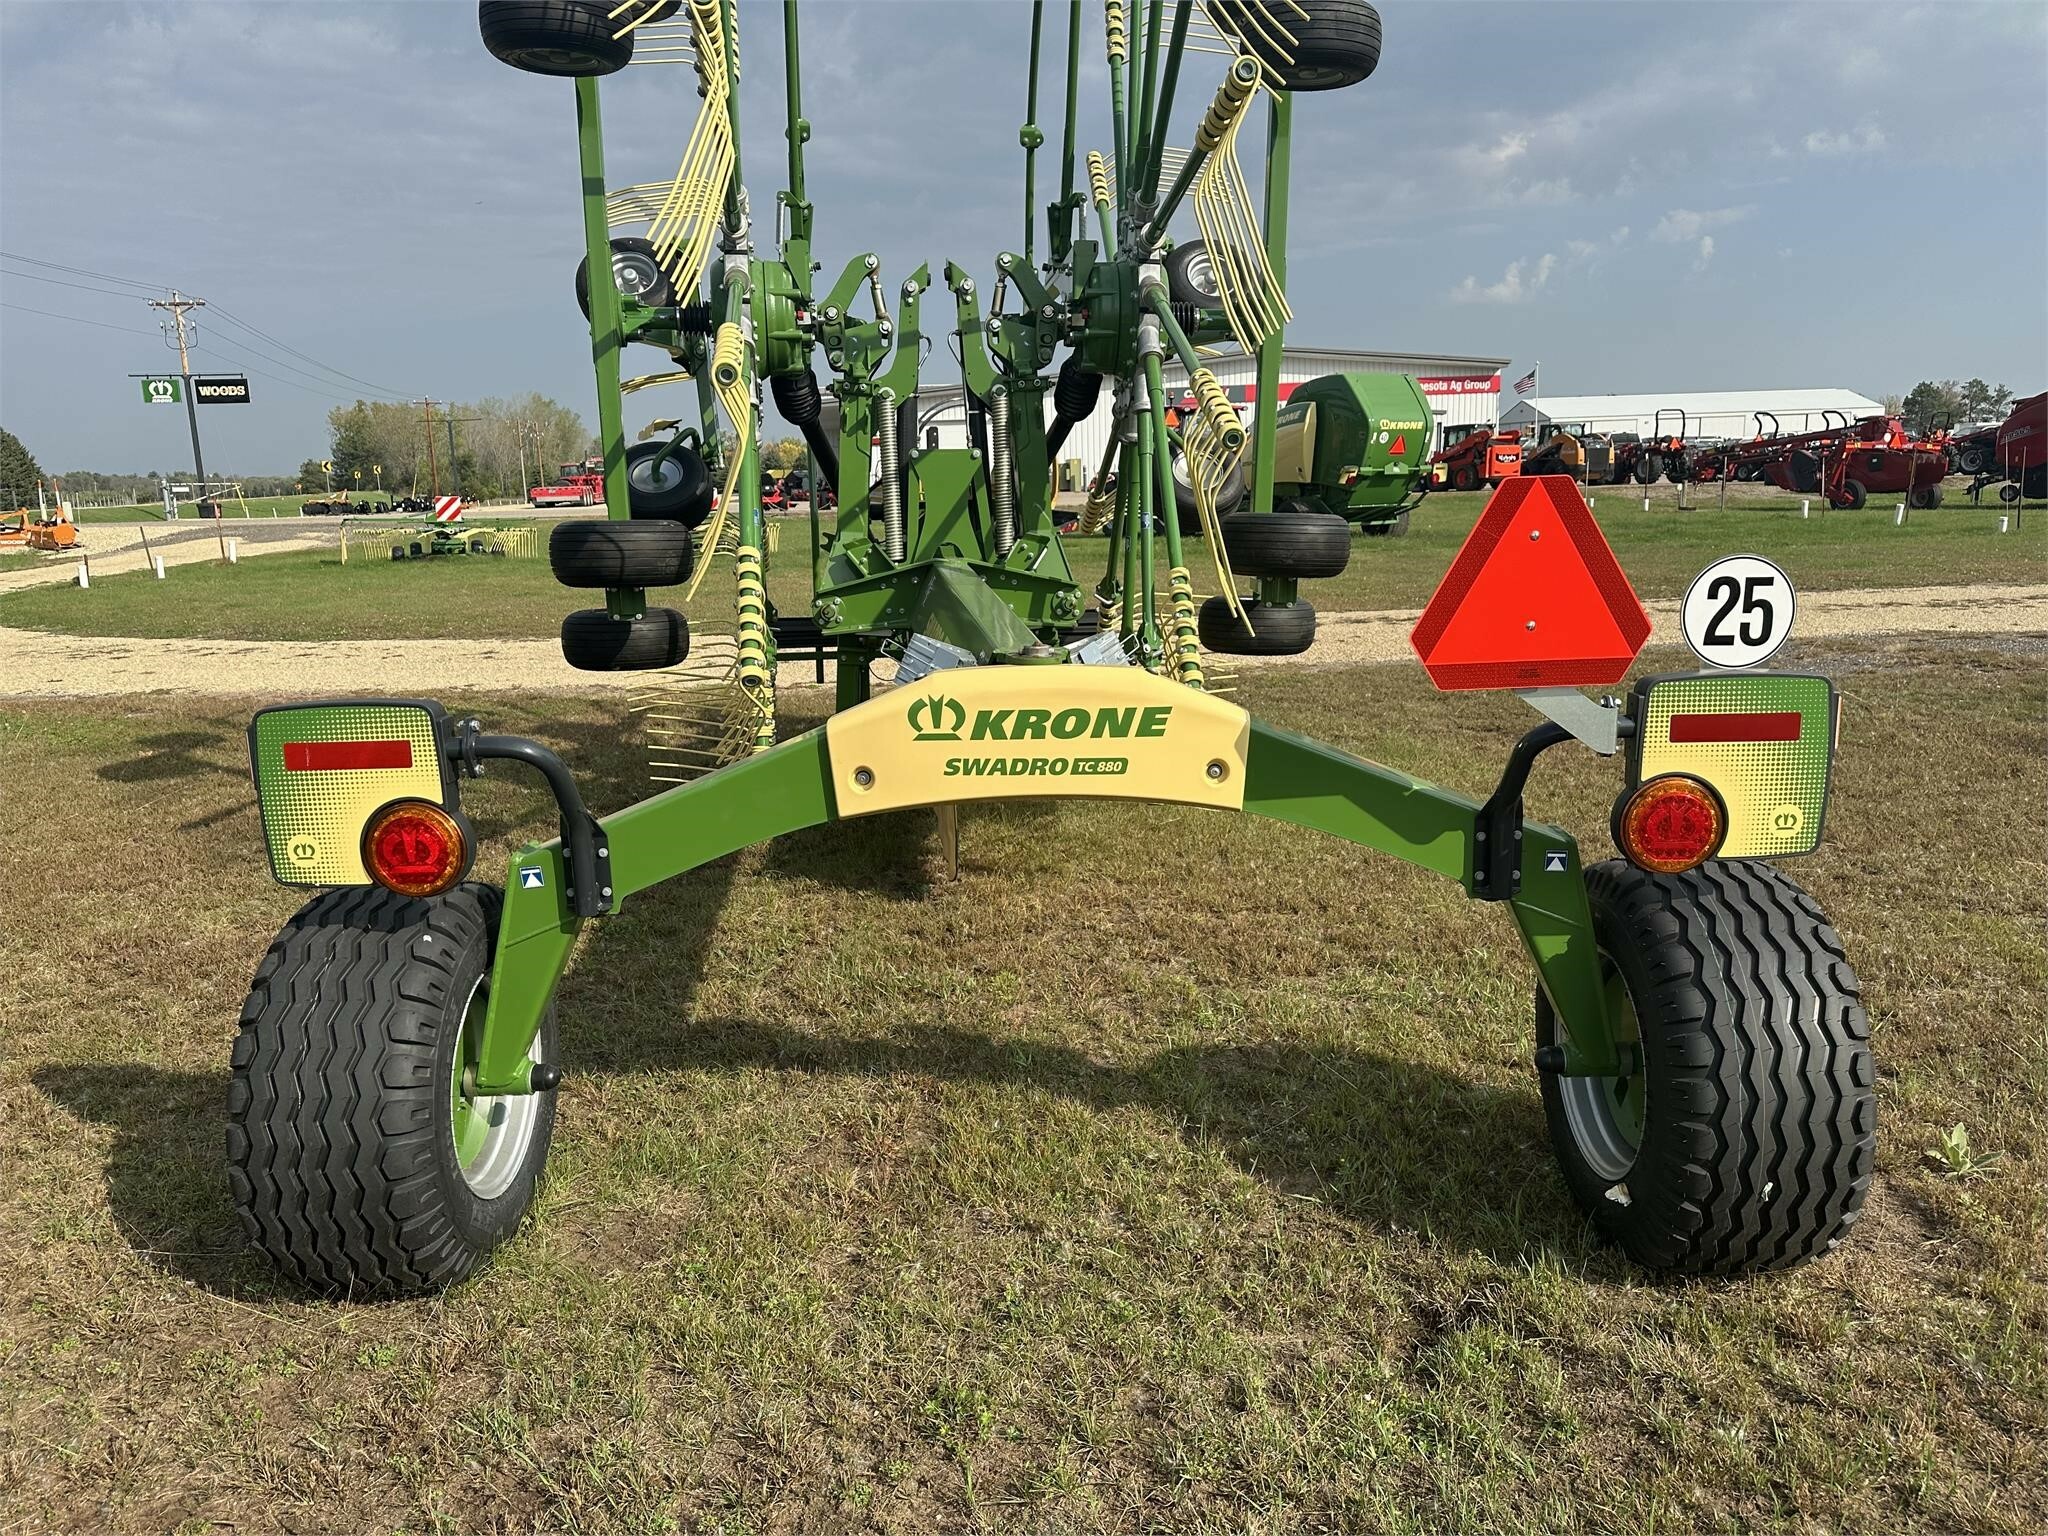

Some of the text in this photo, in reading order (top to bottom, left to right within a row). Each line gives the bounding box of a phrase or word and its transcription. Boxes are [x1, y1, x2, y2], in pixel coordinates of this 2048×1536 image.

[198, 385, 246, 397] WOODS
[1450, 380, 1462, 392] Ag
[1464, 379, 1491, 391] Group
[1389, 421, 1424, 430] KRONE
[1703, 576, 1774, 647] 25
[969, 706, 1173, 741] KRONE
[943, 757, 1123, 776] SWADRO TC 880
